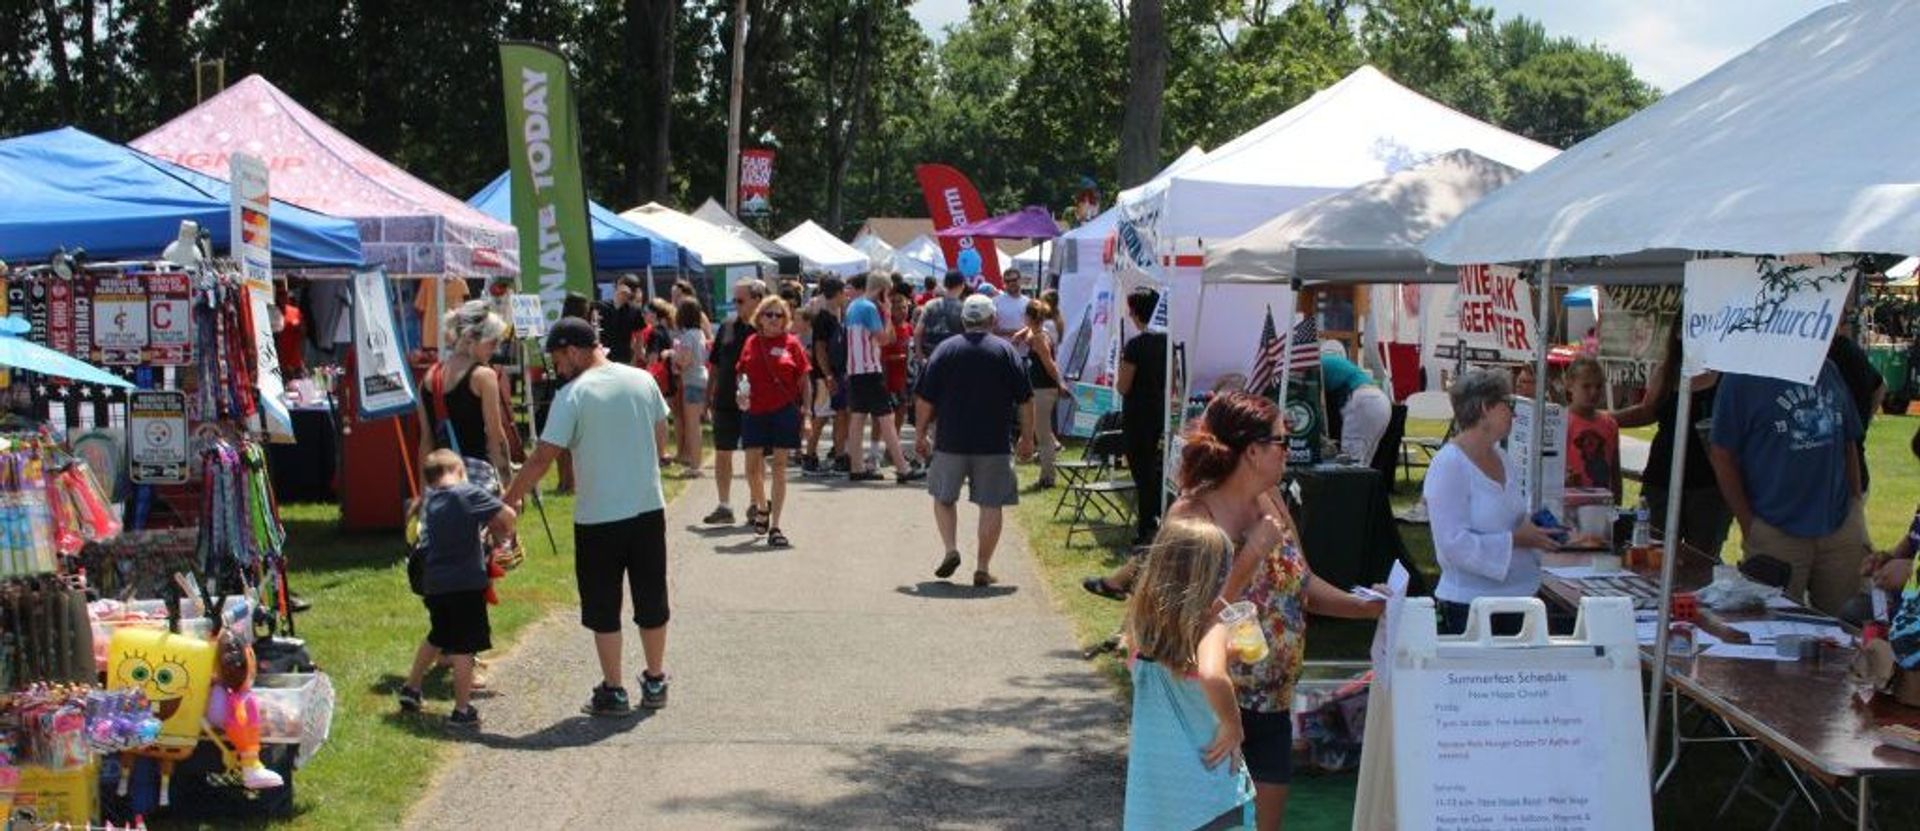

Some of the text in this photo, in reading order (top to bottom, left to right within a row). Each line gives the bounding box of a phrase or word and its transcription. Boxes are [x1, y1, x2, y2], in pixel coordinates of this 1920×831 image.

[522, 66, 567, 345] ONATE TODAY
[1448, 672, 1568, 685] Summerfest Schedule
